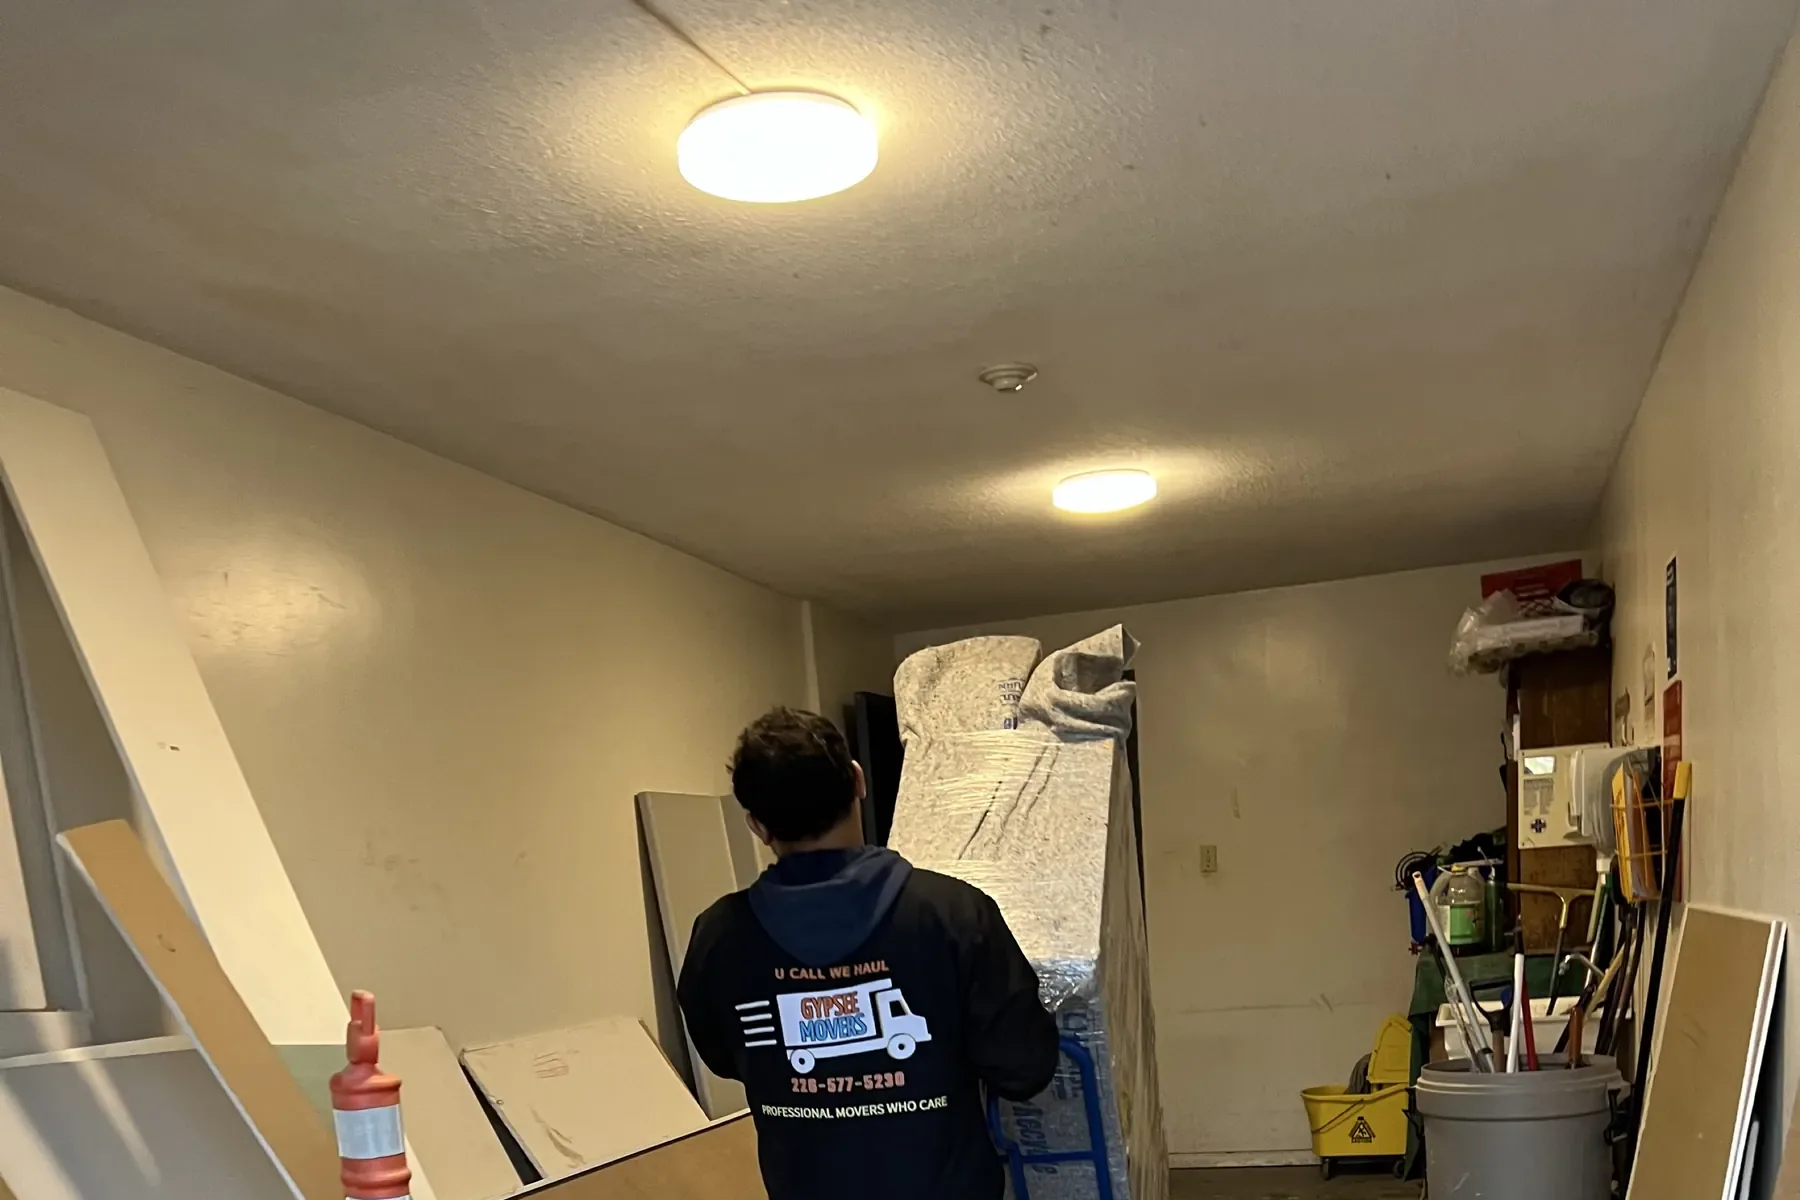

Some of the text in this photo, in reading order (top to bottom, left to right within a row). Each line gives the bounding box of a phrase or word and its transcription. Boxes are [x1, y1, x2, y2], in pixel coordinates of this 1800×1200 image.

[774, 960, 889, 980] U CALL WE HAUL
[801, 991, 860, 1020] GYPSEE
[799, 1012, 868, 1043] MOVERS
[761, 1096, 948, 1119] PROFESSIONAL MOVERS WHO CARE
